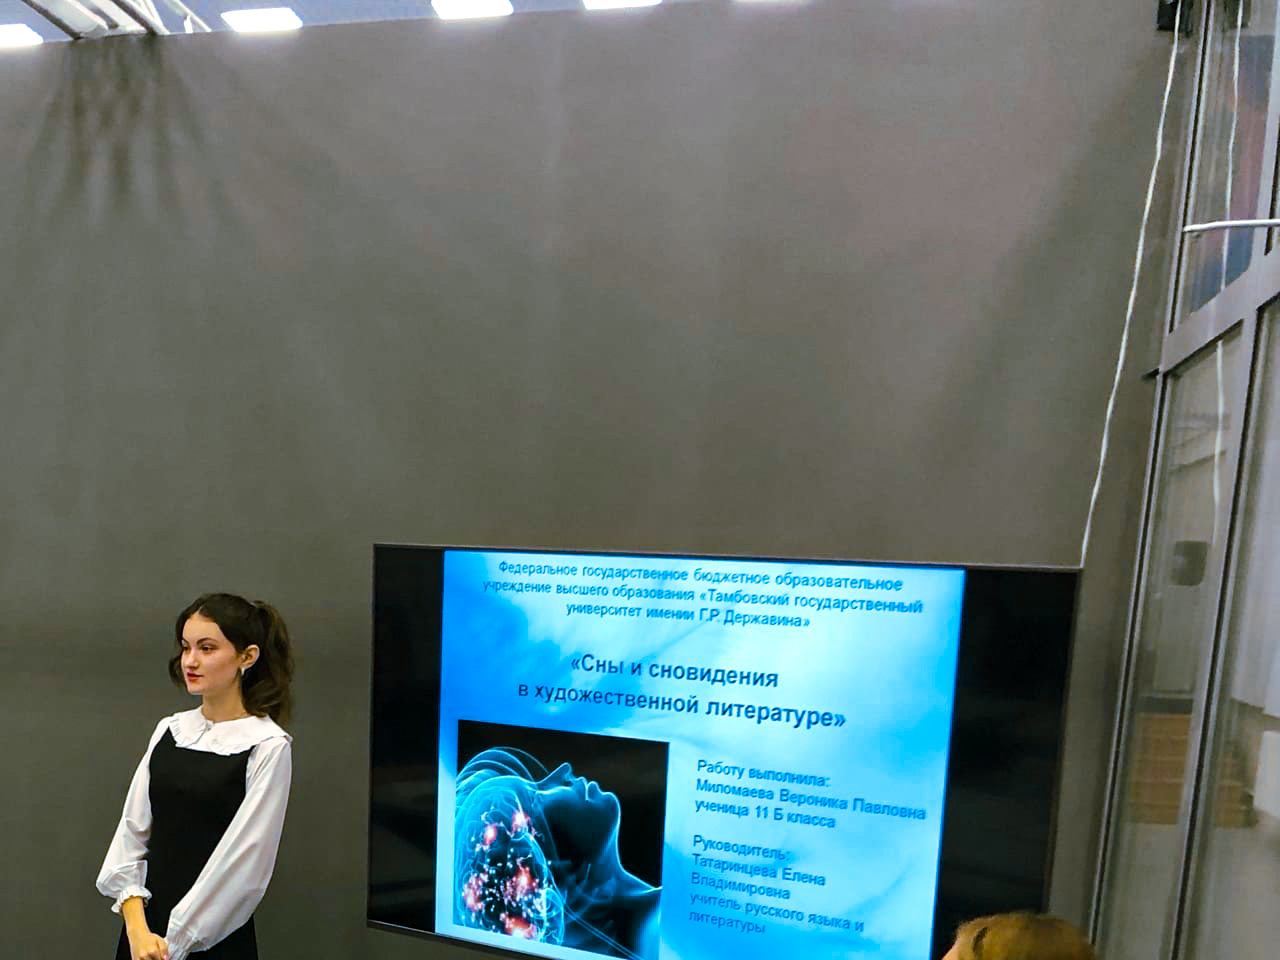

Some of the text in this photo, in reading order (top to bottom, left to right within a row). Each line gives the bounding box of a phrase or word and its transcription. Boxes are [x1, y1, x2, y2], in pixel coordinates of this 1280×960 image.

[498, 560, 904, 592] Федеральное государственное бюджетное образовательное
[482, 579, 924, 615] учреждение высшего образования «Тамбовский государственный
[566, 602, 642, 618] университет
[723, 609, 811, 628] Державина»
[570, 652, 780, 688] «Сны и сновидения
[518, 682, 847, 730] в художественной литературе»
[697, 759, 831, 788] Работу выполнила:
[695, 799, 836, 828] ученица 11 Б класса
[696, 778, 926, 820] Миломаева Вероника Павловна
[693, 834, 792, 861] Руководитель:
[692, 853, 826, 886] Татаринцева Елена
[691, 872, 791, 900] Владимировна
[688, 908, 765, 934] литературы
[690, 891, 864, 932] учитель русского языка и
